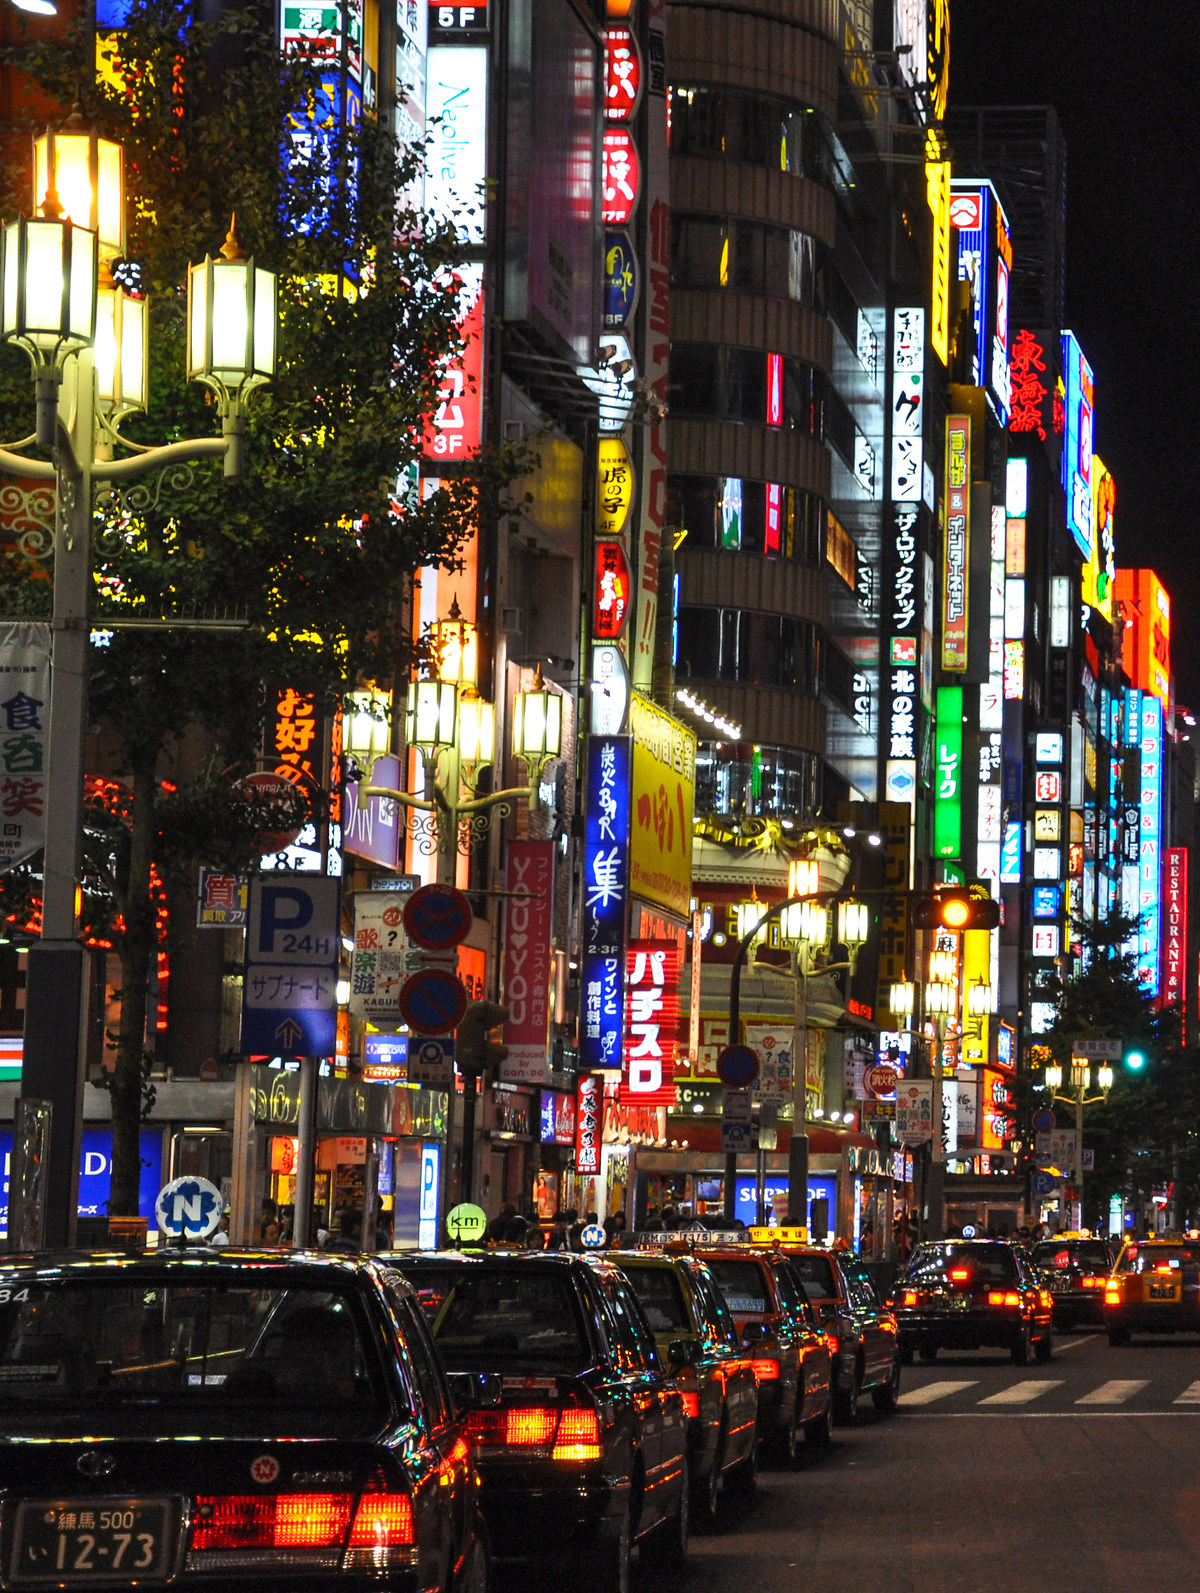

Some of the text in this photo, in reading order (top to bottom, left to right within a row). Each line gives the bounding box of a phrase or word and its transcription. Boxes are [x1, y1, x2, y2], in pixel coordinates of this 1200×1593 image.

[438, 7, 475, 27] 5F
[438, 82, 470, 180] Neolive
[434, 435, 463, 453] 3F
[602, 467, 627, 514] 虎の子
[894, 512, 917, 629] ザ・ロックアップ
[948, 514, 964, 622] インターネット
[891, 669, 915, 758] 北の家族
[939, 745, 957, 798] レイク
[986, 787, 995, 839] カラオケ
[1003, 824, 1020, 872] 747
[204, 874, 237, 909] 質
[586, 846, 624, 907] 集
[259, 885, 314, 952] P
[1169, 854, 1180, 973] RESTAURANT
[282, 933, 329, 955] 24H
[587, 981, 600, 1039] 創作料理
[604, 958, 618, 1015] ワインと
[629, 951, 667, 1092] パチスロ
[967, 1049, 983, 1059] 2F
[172, 1195, 202, 1222] N
[451, 1216, 479, 1228] km
[57, 1511, 135, 1530] 練馬 500
[29, 1534, 154, 1570] い 12-73
